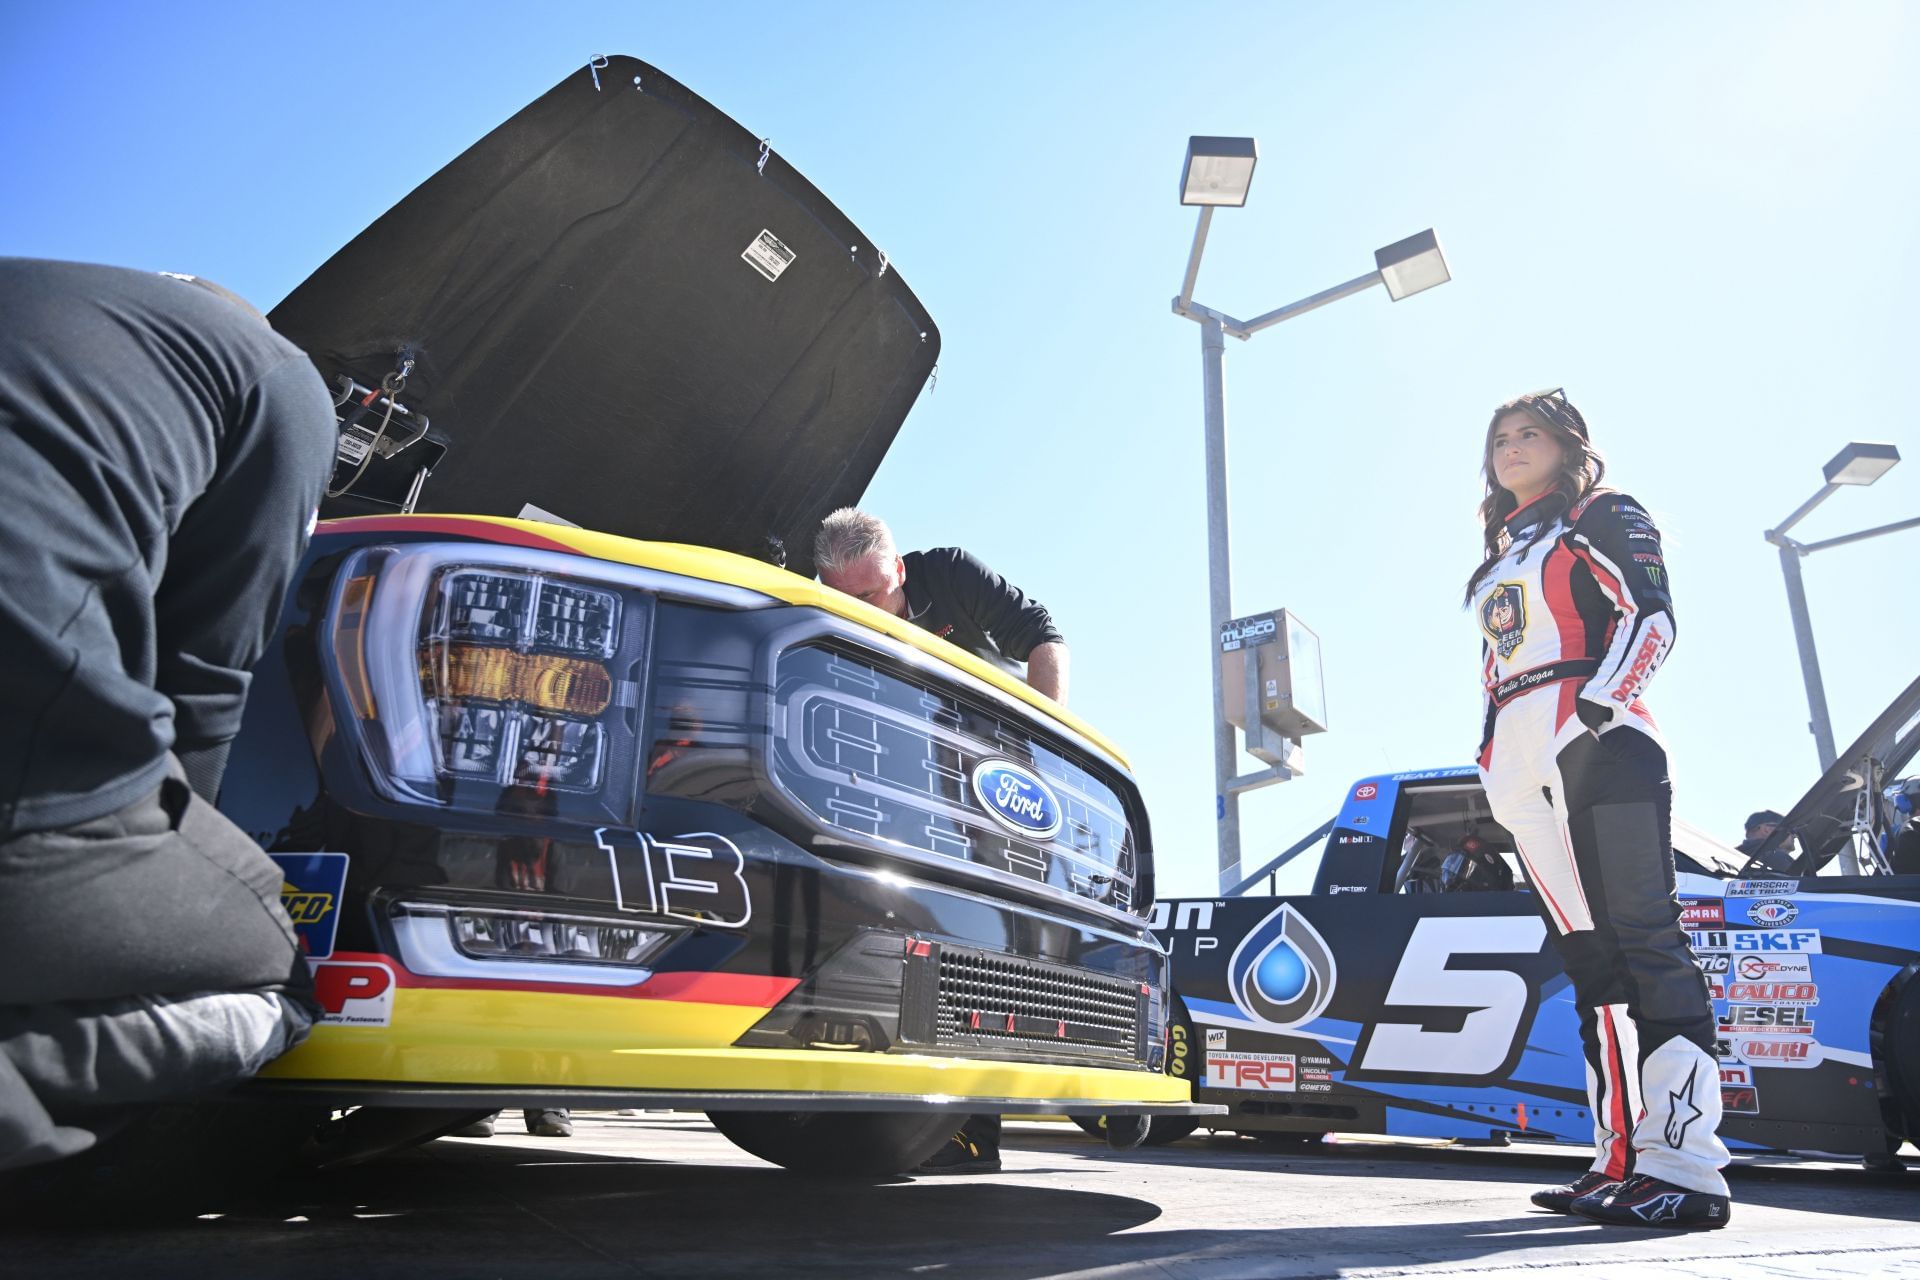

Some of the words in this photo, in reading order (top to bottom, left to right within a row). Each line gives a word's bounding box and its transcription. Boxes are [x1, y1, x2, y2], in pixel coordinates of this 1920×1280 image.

[1611, 625, 1662, 702] ODYSSEY
[1498, 680, 1519, 697] Hailie
[1520, 668, 1554, 686] Deegan
[1392, 771, 1434, 781] DEAN
[996, 773, 1043, 821] Ford
[595, 828, 752, 928] 13
[1683, 910, 1719, 918] SMAN
[1734, 933, 1816, 951] SKF
[1361, 916, 1548, 1076] 5
[1728, 983, 1815, 1000] CALICO
[1718, 1007, 1811, 1026] JESEL
[1208, 1031, 1224, 1042] WIX
[1171, 1024, 1188, 1077] GOO
[1307, 1056, 1331, 1065] YAMAHA
[1208, 1060, 1294, 1088] TRD
